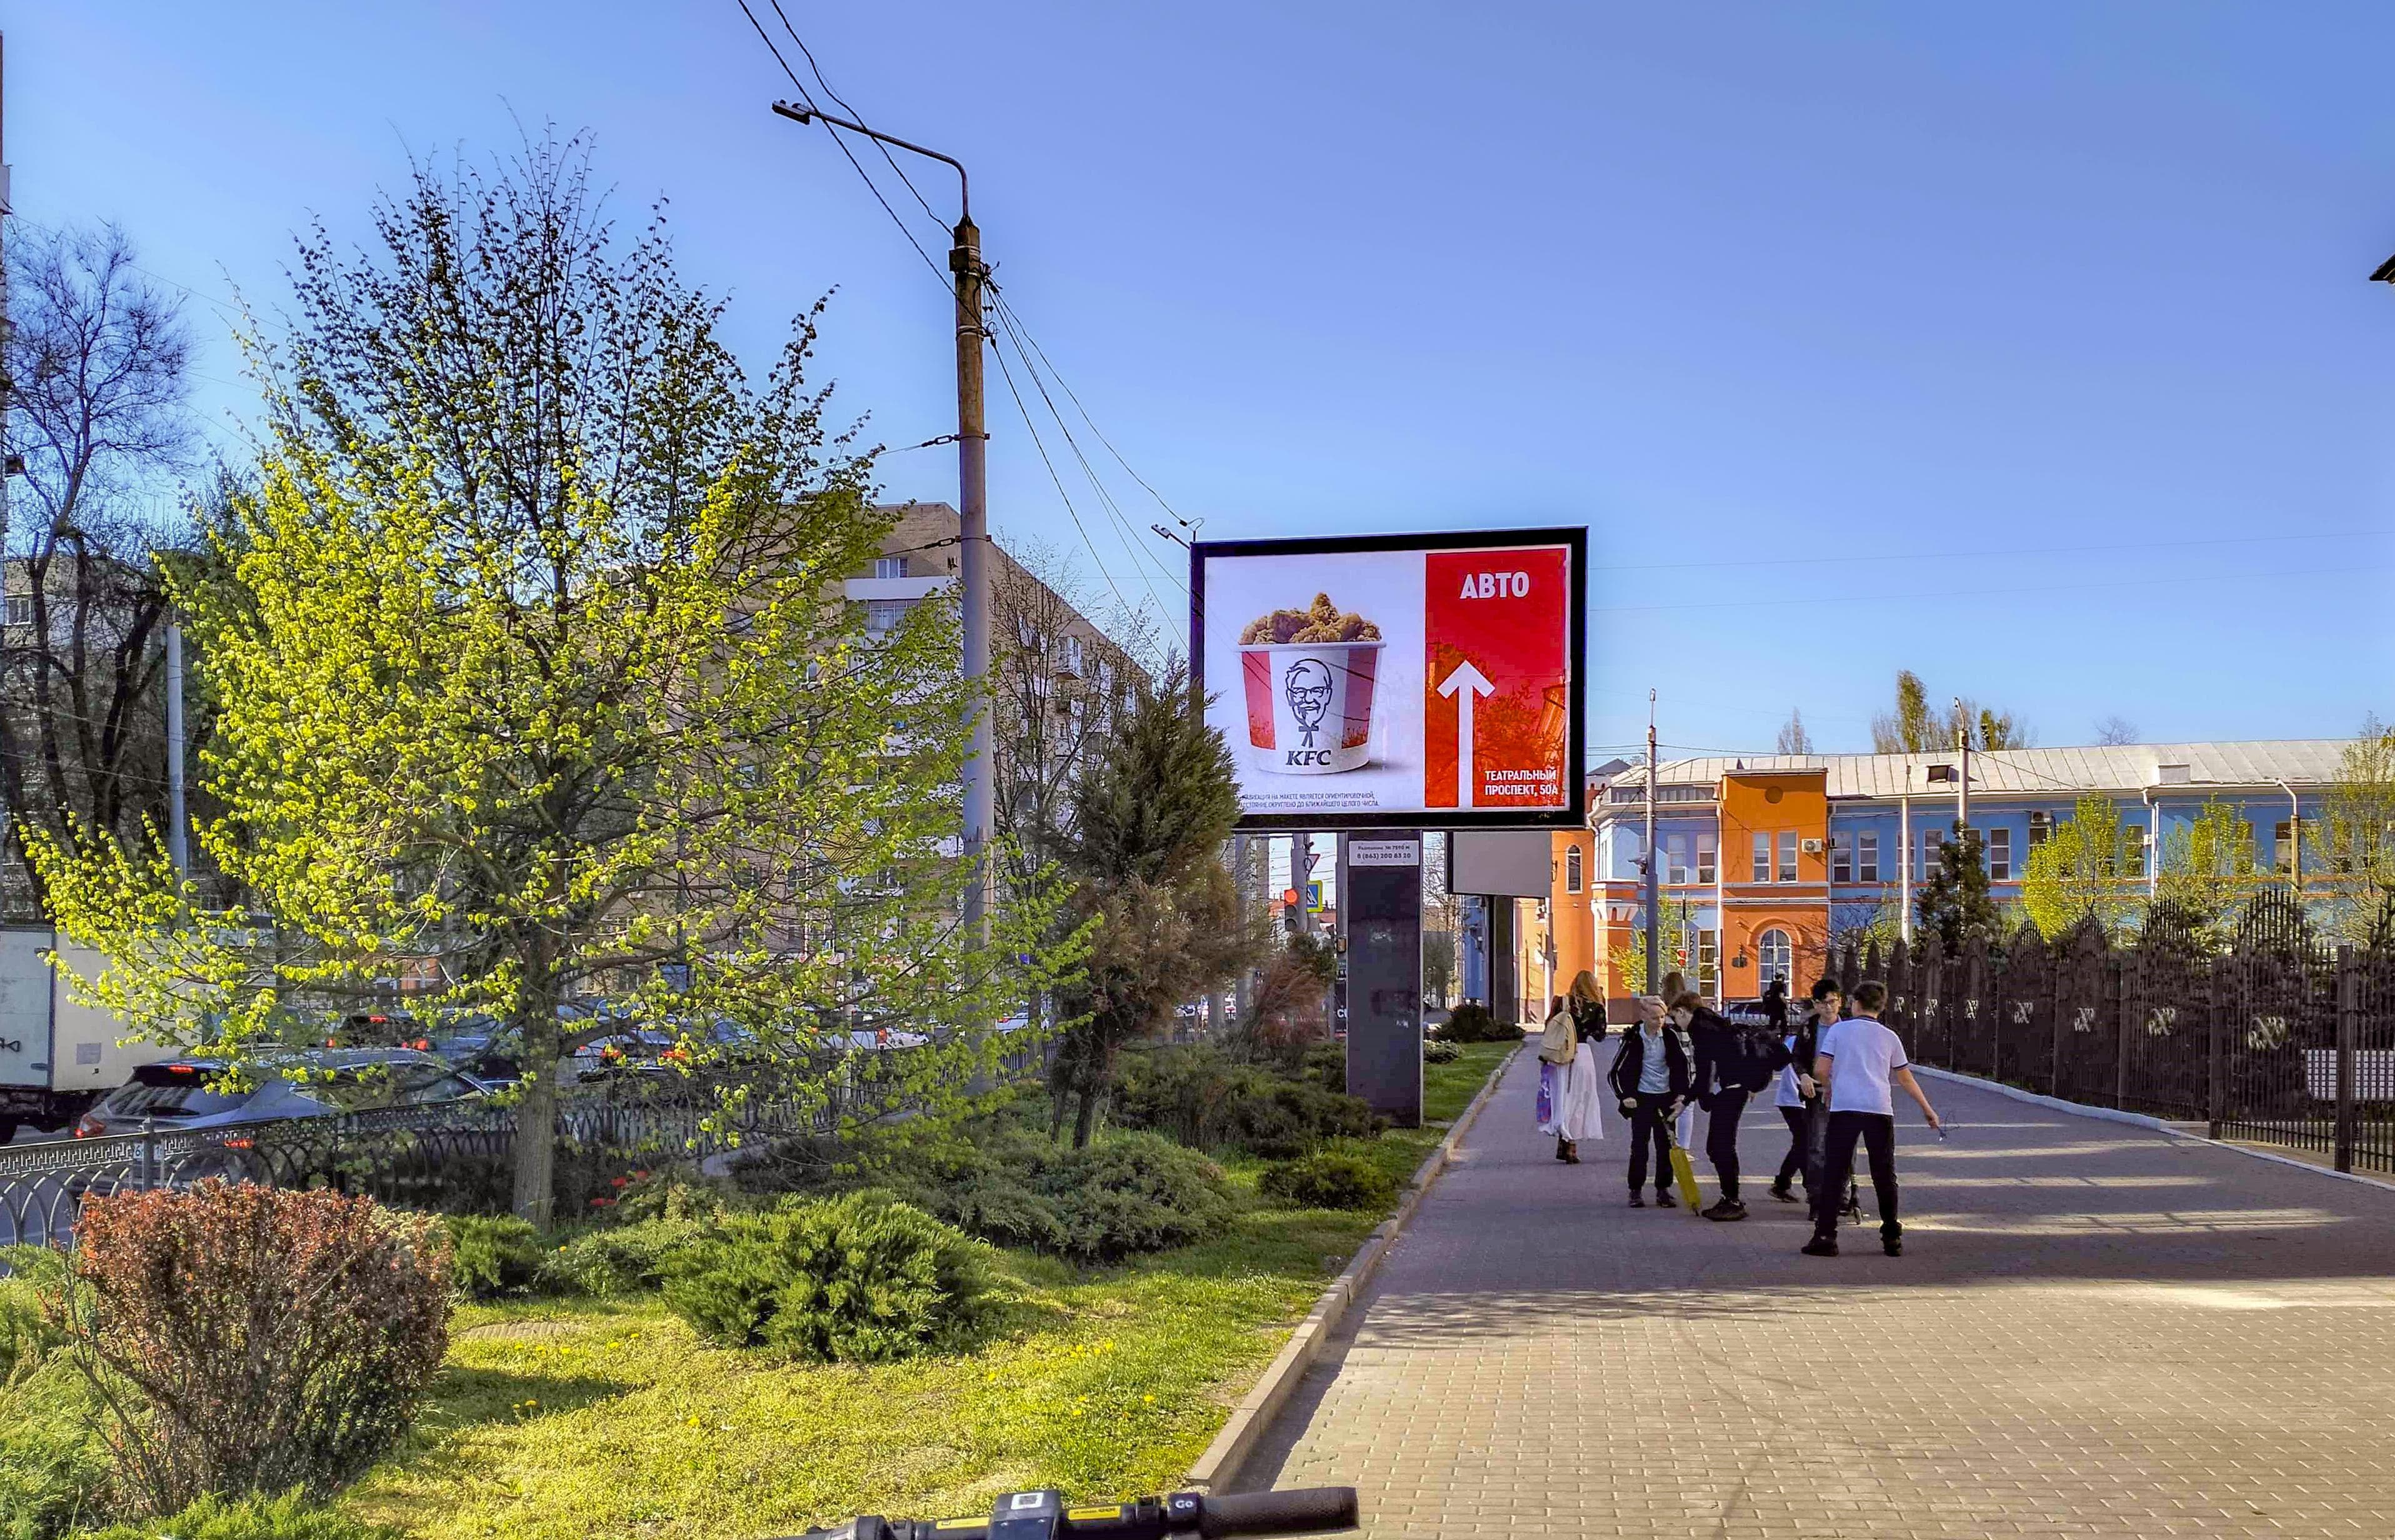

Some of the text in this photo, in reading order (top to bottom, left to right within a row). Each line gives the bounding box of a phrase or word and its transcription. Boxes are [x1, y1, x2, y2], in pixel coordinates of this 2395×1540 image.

[1459, 571, 1529, 599] АВТО
[1285, 749, 1331, 766] KFC
[1485, 766, 1556, 781] ТЕАТРАЛЬНЫЙ
[1485, 784, 1558, 797] ПРОСПЕКТ, 50А
